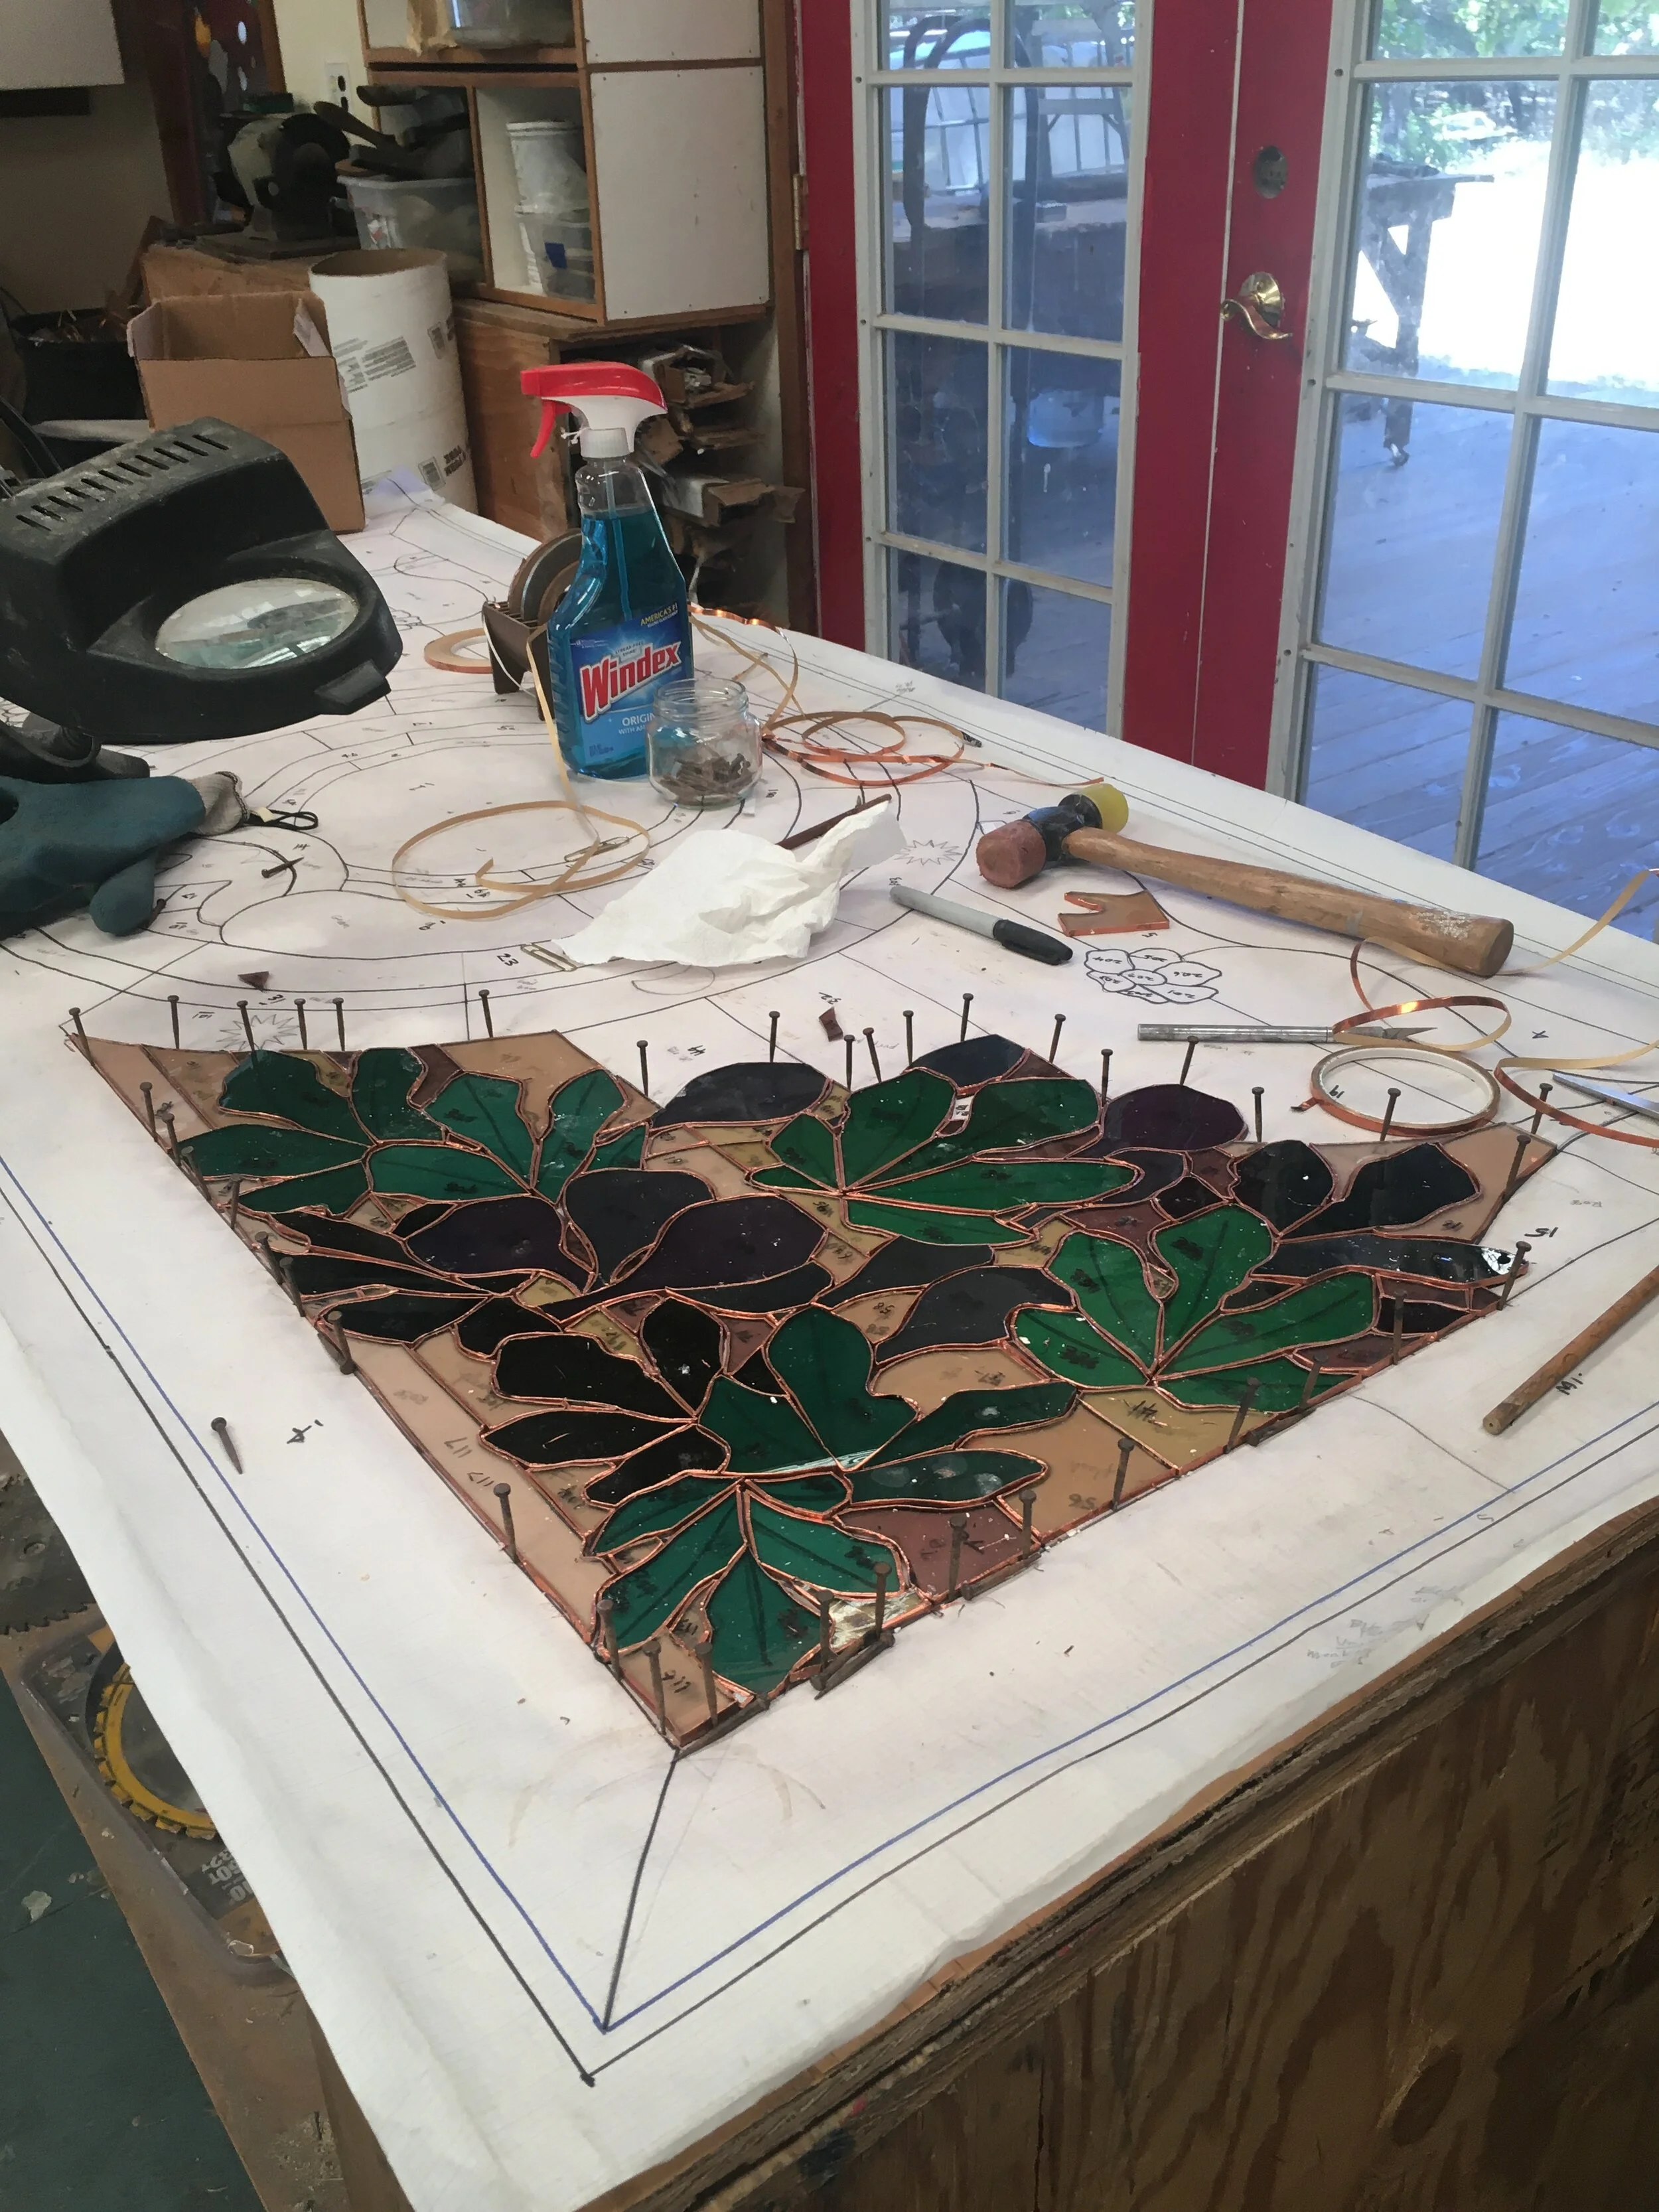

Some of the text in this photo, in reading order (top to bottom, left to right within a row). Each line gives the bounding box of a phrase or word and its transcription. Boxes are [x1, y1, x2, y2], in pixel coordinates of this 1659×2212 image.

[640, 605, 671, 626] AMERICA'S
[581, 642, 680, 721] Windex
[622, 713, 656, 727] ORIGIN
